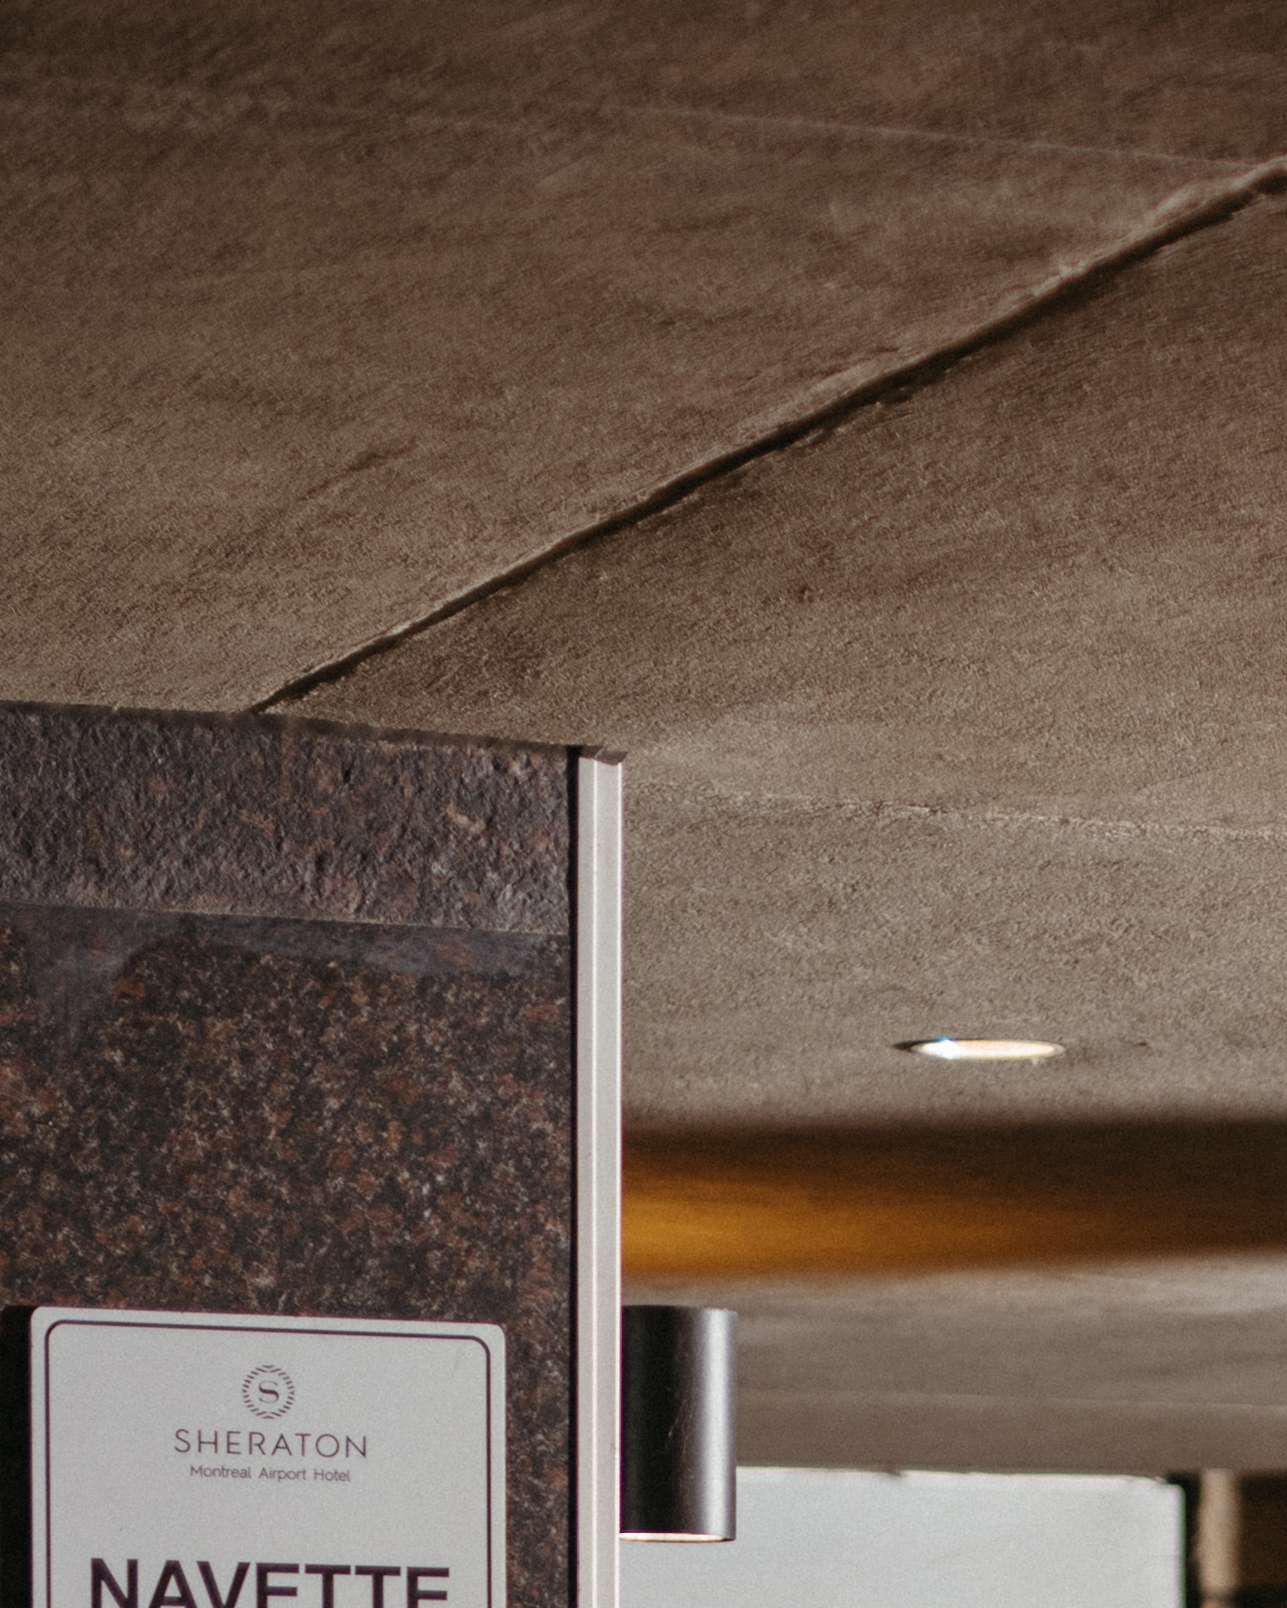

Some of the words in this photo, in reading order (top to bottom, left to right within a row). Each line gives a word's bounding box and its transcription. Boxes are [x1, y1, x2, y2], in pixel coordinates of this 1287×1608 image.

[174, 1429, 366, 1458] SHERATON
[190, 1465, 251, 1480] Montreal
[259, 1466, 306, 1483] Airport
[313, 1467, 350, 1482] Hotel
